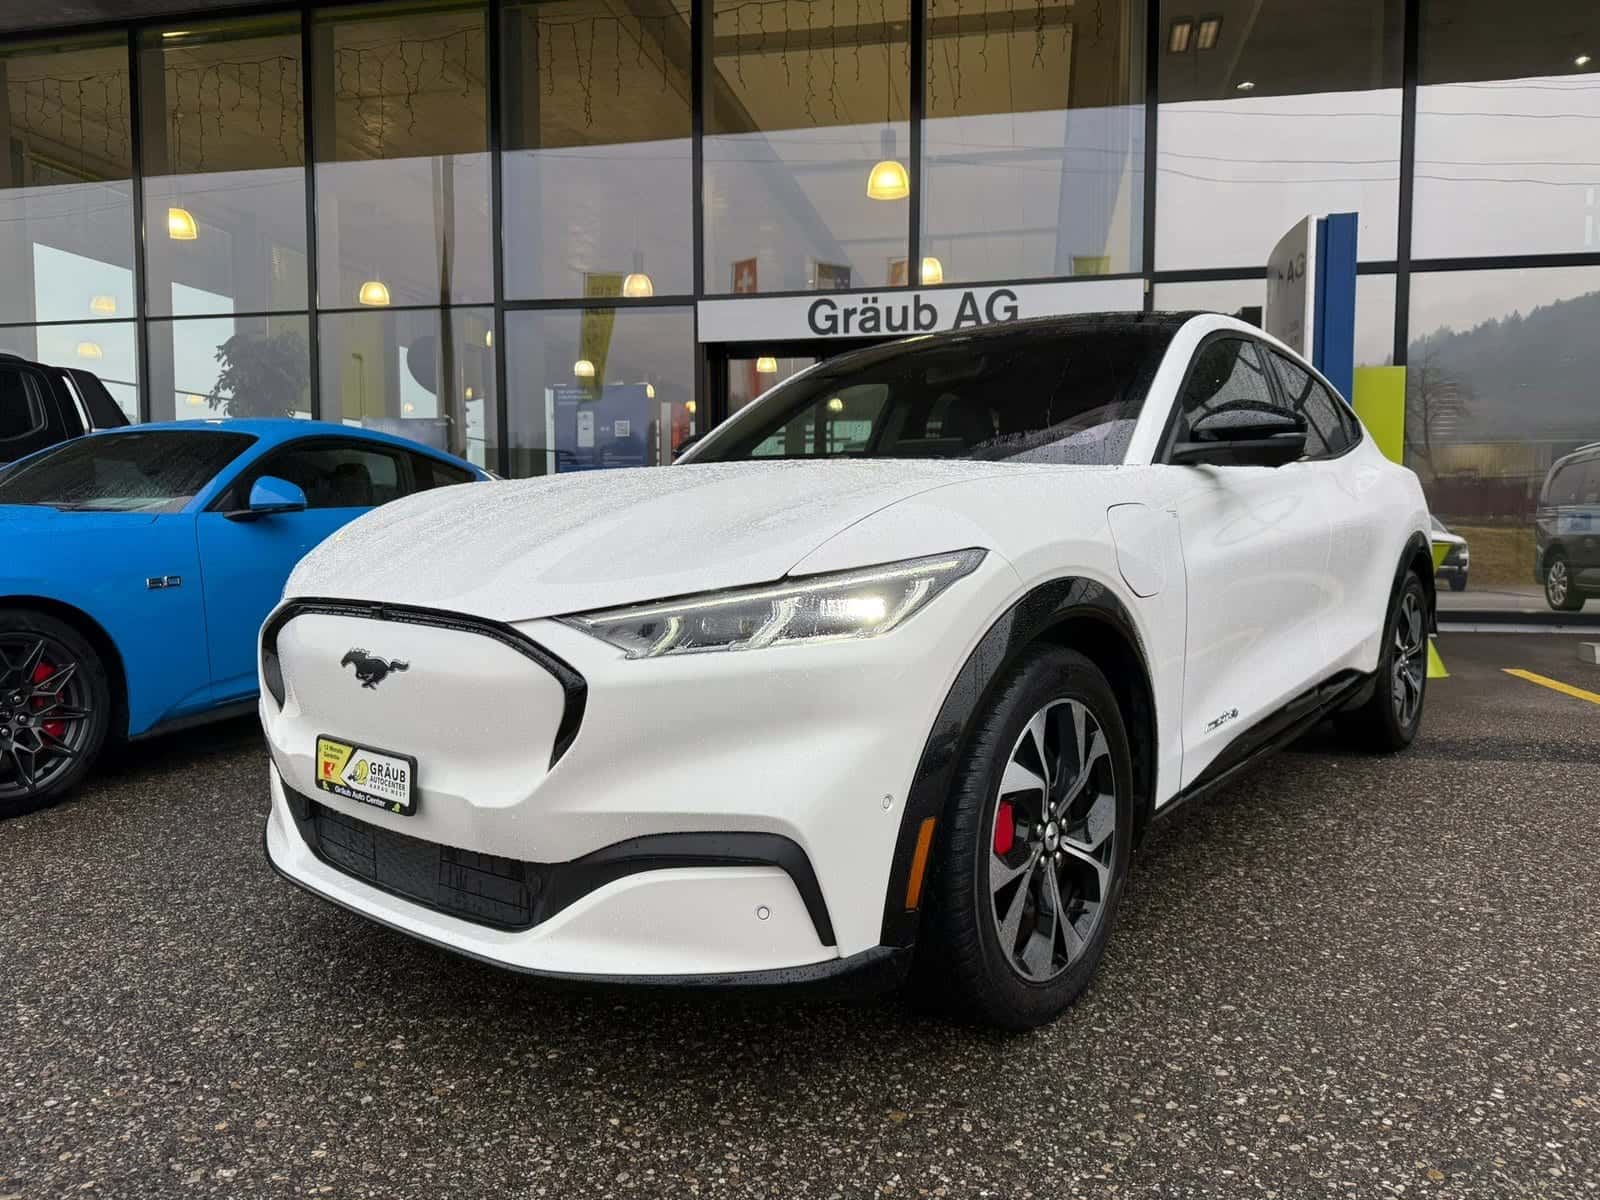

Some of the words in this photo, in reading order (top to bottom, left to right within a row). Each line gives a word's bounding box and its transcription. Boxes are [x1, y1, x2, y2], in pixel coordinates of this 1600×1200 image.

[1287, 252, 1305, 283] AG
[808, 294, 938, 336] Gräub
[952, 288, 1018, 330] AG
[370, 762, 406, 783] GRÄUB
[370, 776, 405, 791] AUTOCENTER
[352, 791, 365, 801] Auto
[366, 794, 386, 807] Center
